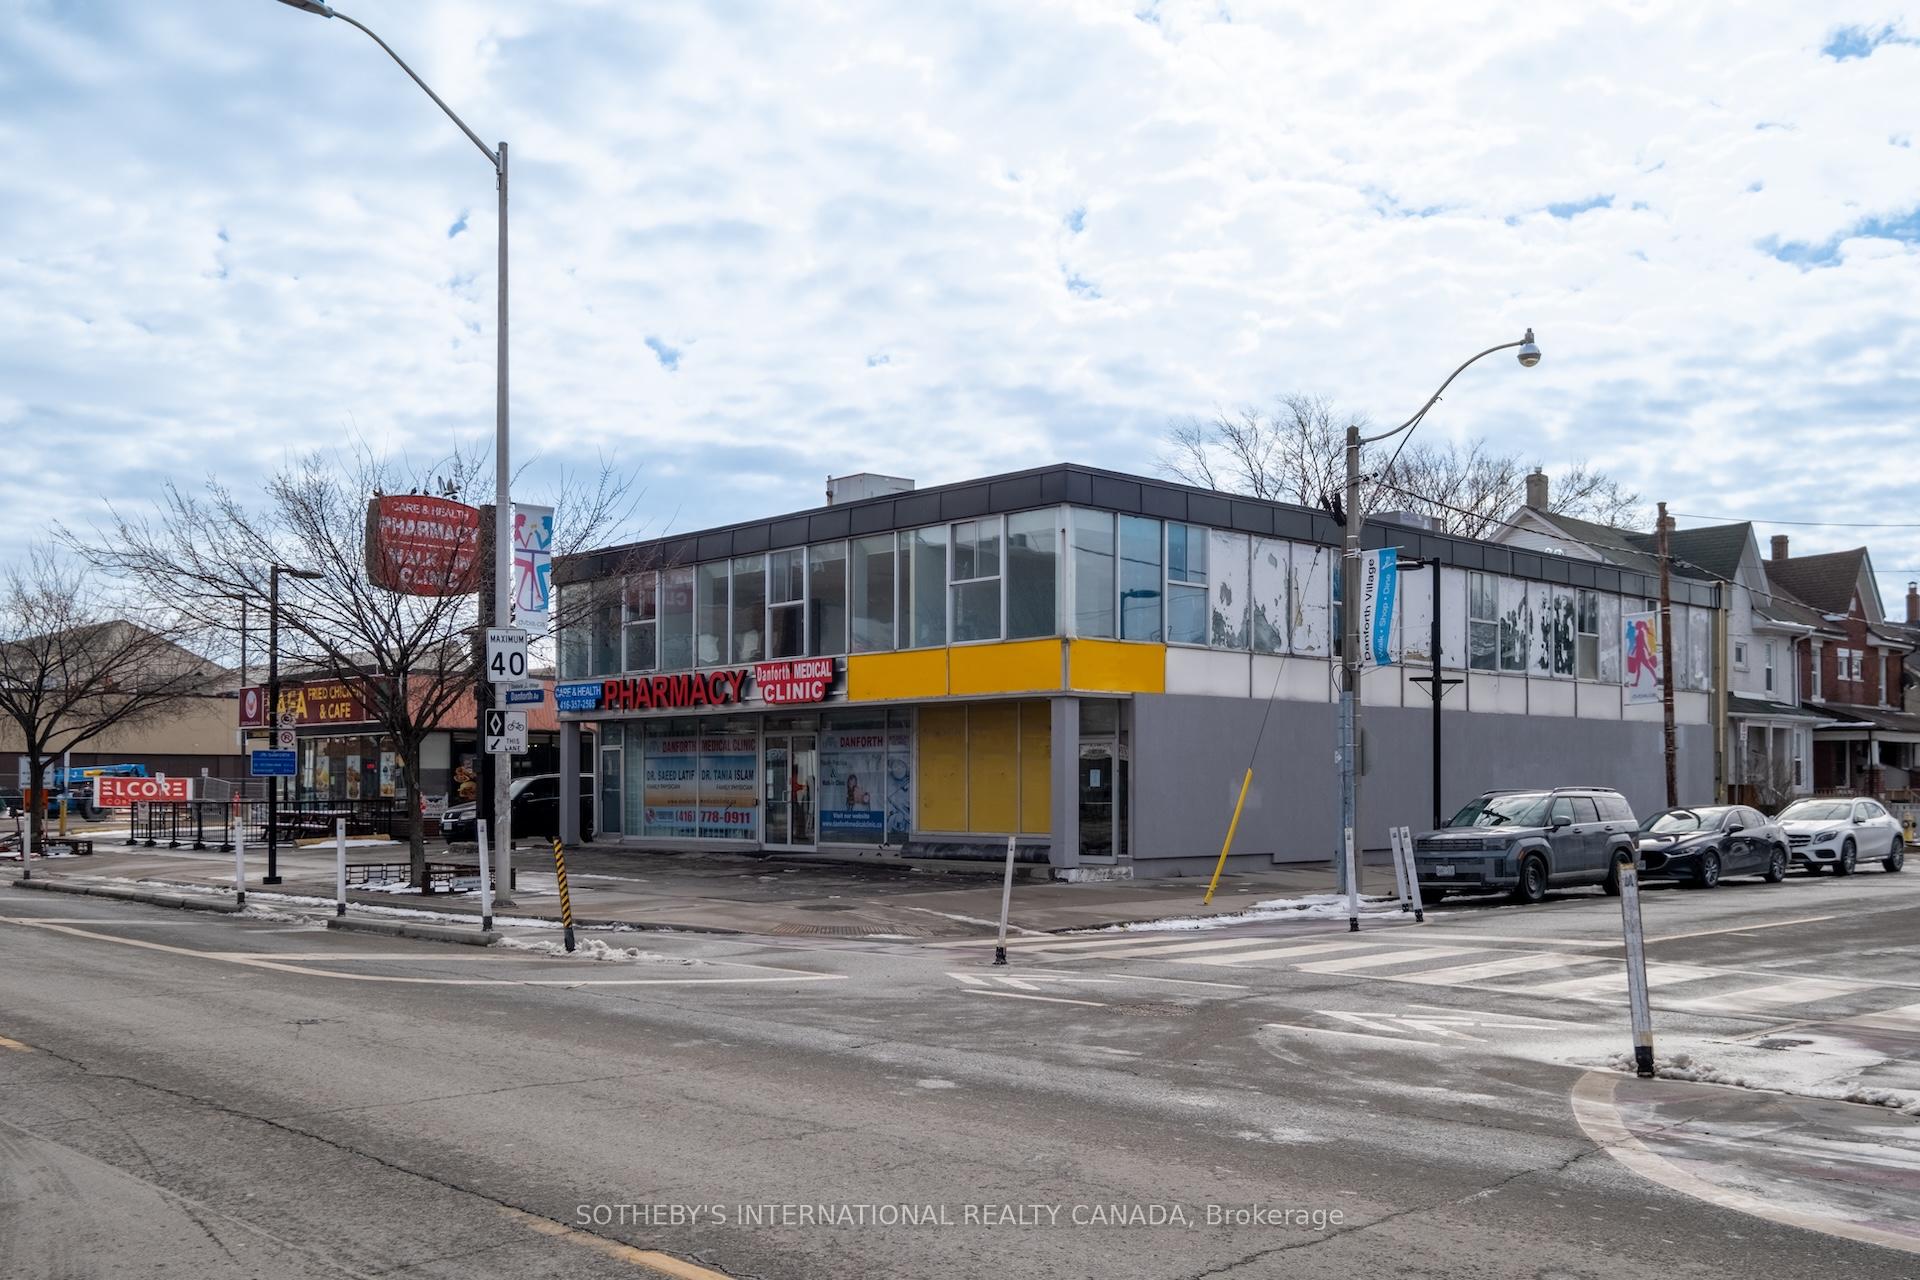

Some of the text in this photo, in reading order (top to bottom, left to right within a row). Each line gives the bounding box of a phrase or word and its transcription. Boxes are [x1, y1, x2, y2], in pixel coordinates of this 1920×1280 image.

[392, 501, 469, 521] CARE & HEALTH
[379, 515, 479, 543] PHARMACY
[1383, 573, 1392, 595] Dine
[1363, 558, 1376, 661] Danforth Village
[1379, 602, 1389, 627] Shop
[490, 634, 525, 643] MAXIMUM
[490, 651, 525, 676] 40
[757, 661, 832, 682] Danforth MEDICAL
[308, 687, 328, 700] FRIED
[555, 685, 601, 698] CARE & HEALTH
[603, 669, 748, 711] PHARMACY
[763, 681, 823, 702] CLINIC
[319, 702, 351, 719] & CAFE
[662, 739, 756, 753] DANFORTH MEDICAL CLINIC
[840, 736, 884, 748] DANFORTH
[658, 770, 677, 780] SAEED
[678, 769, 695, 780] LATIF
[701, 769, 754, 780] DR. TANIA ISLAM
[102, 781, 184, 797] ELCORE
[675, 810, 697, 822] (416)
[701, 810, 751, 824] 778-0911
